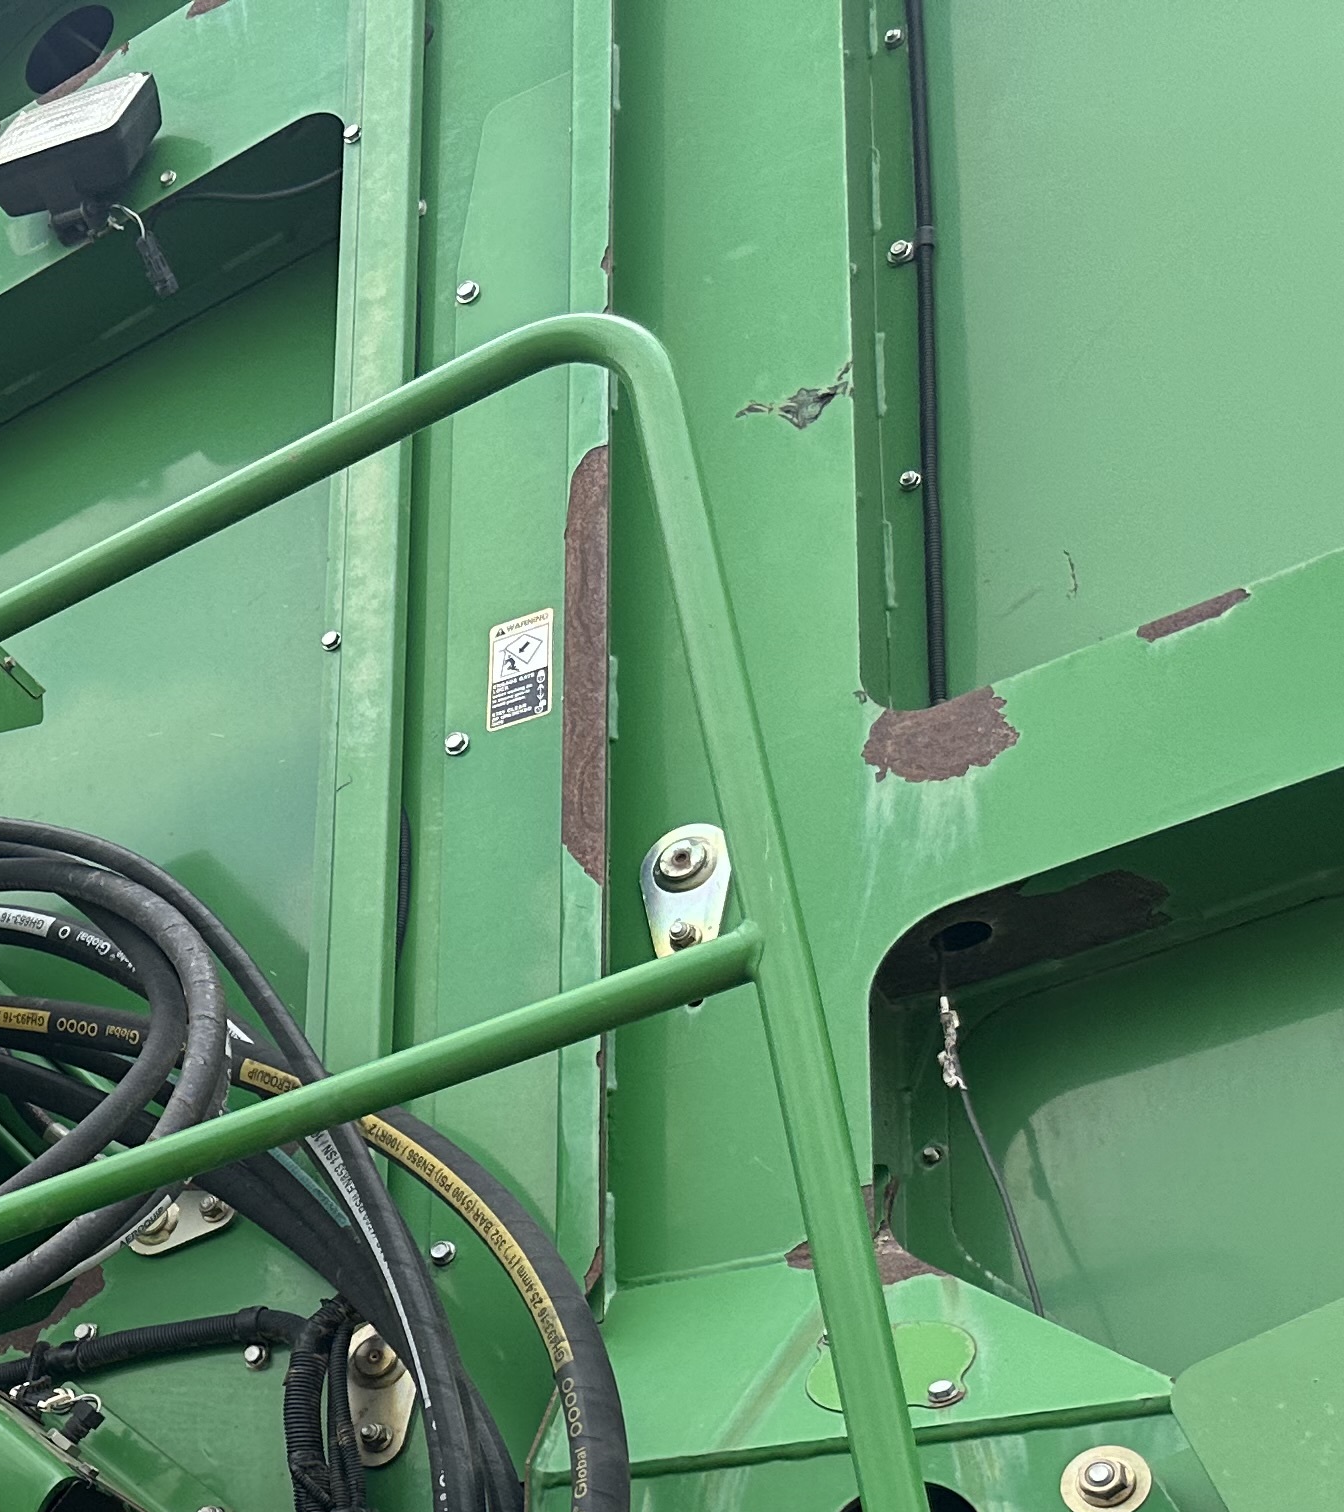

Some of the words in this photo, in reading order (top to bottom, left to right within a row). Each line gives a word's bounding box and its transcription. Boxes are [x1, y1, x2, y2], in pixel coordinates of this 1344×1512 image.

[506, 612, 549, 633] WARNING
[75, 930, 112, 956] Global
[0, 1011, 46, 1028] GH493-16
[105, 1023, 140, 1046] Global
[406, 1148, 436, 1178] EN856
[472, 1210, 494, 1237] BAR
[489, 1227, 507, 1251] 352
[537, 1306, 567, 1363] GH493-16
[573, 1446, 589, 1500] Global
